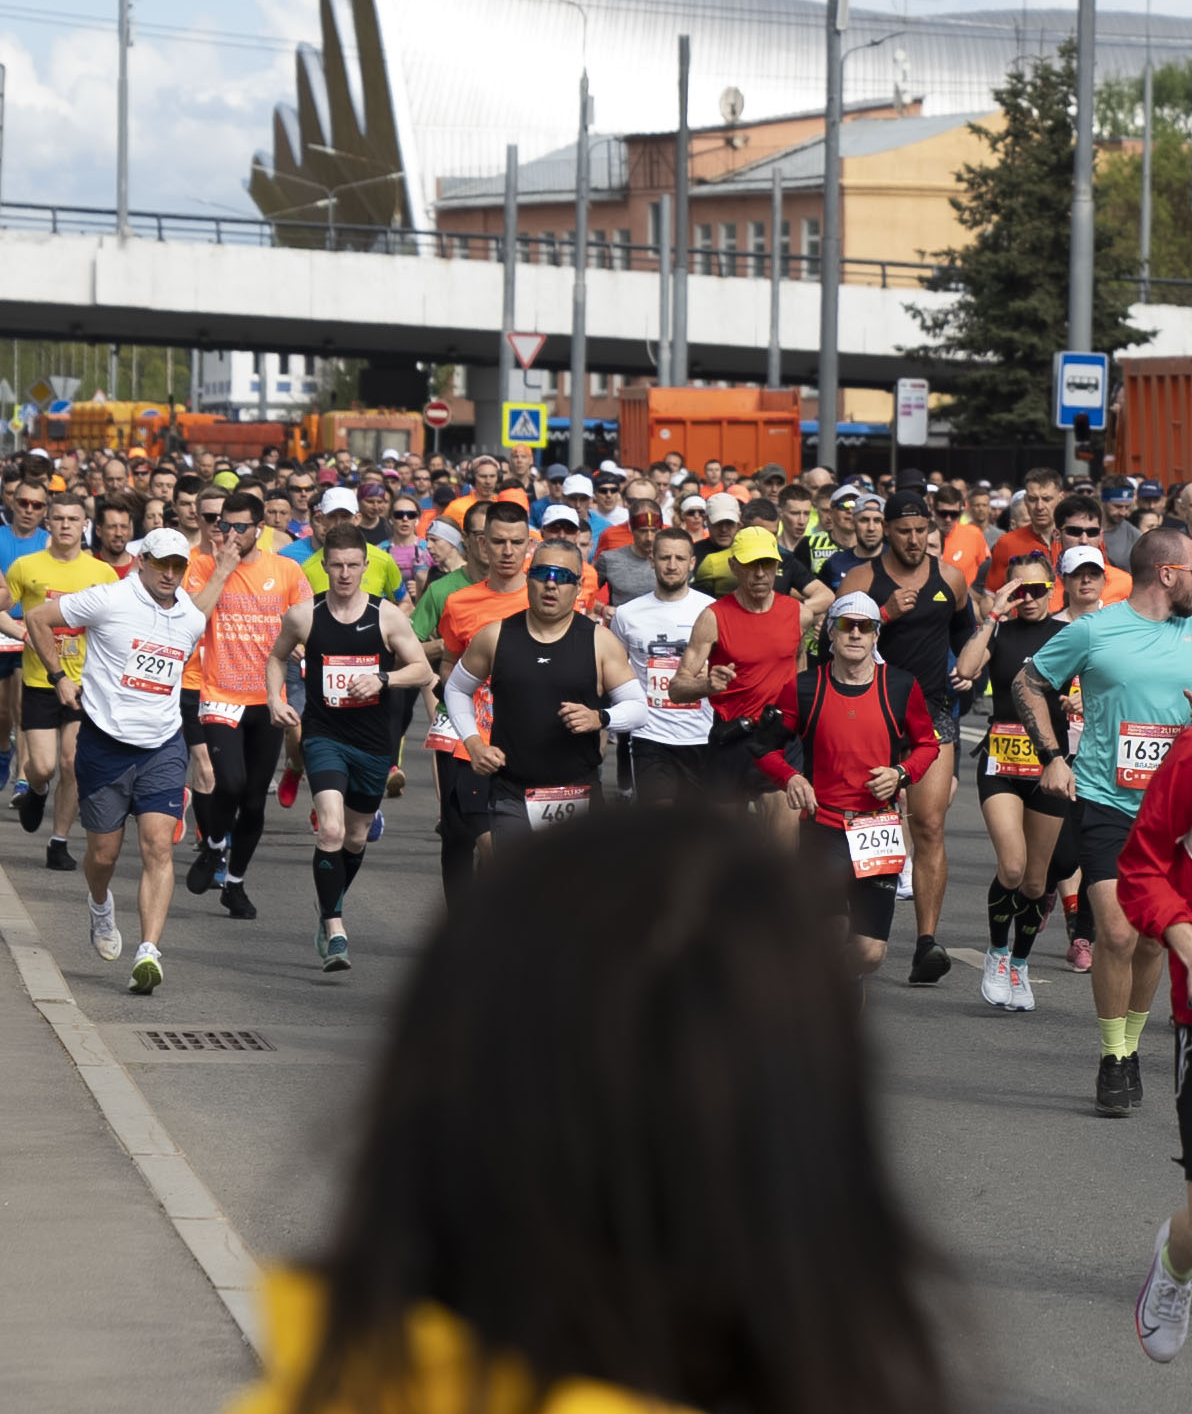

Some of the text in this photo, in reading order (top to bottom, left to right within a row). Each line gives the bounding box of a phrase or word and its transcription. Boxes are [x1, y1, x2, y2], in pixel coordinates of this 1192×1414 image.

[136, 654, 174, 678] 9291
[1123, 740, 1172, 761] 1632
[541, 803, 575, 823] 469
[857, 828, 899, 850] 2694
